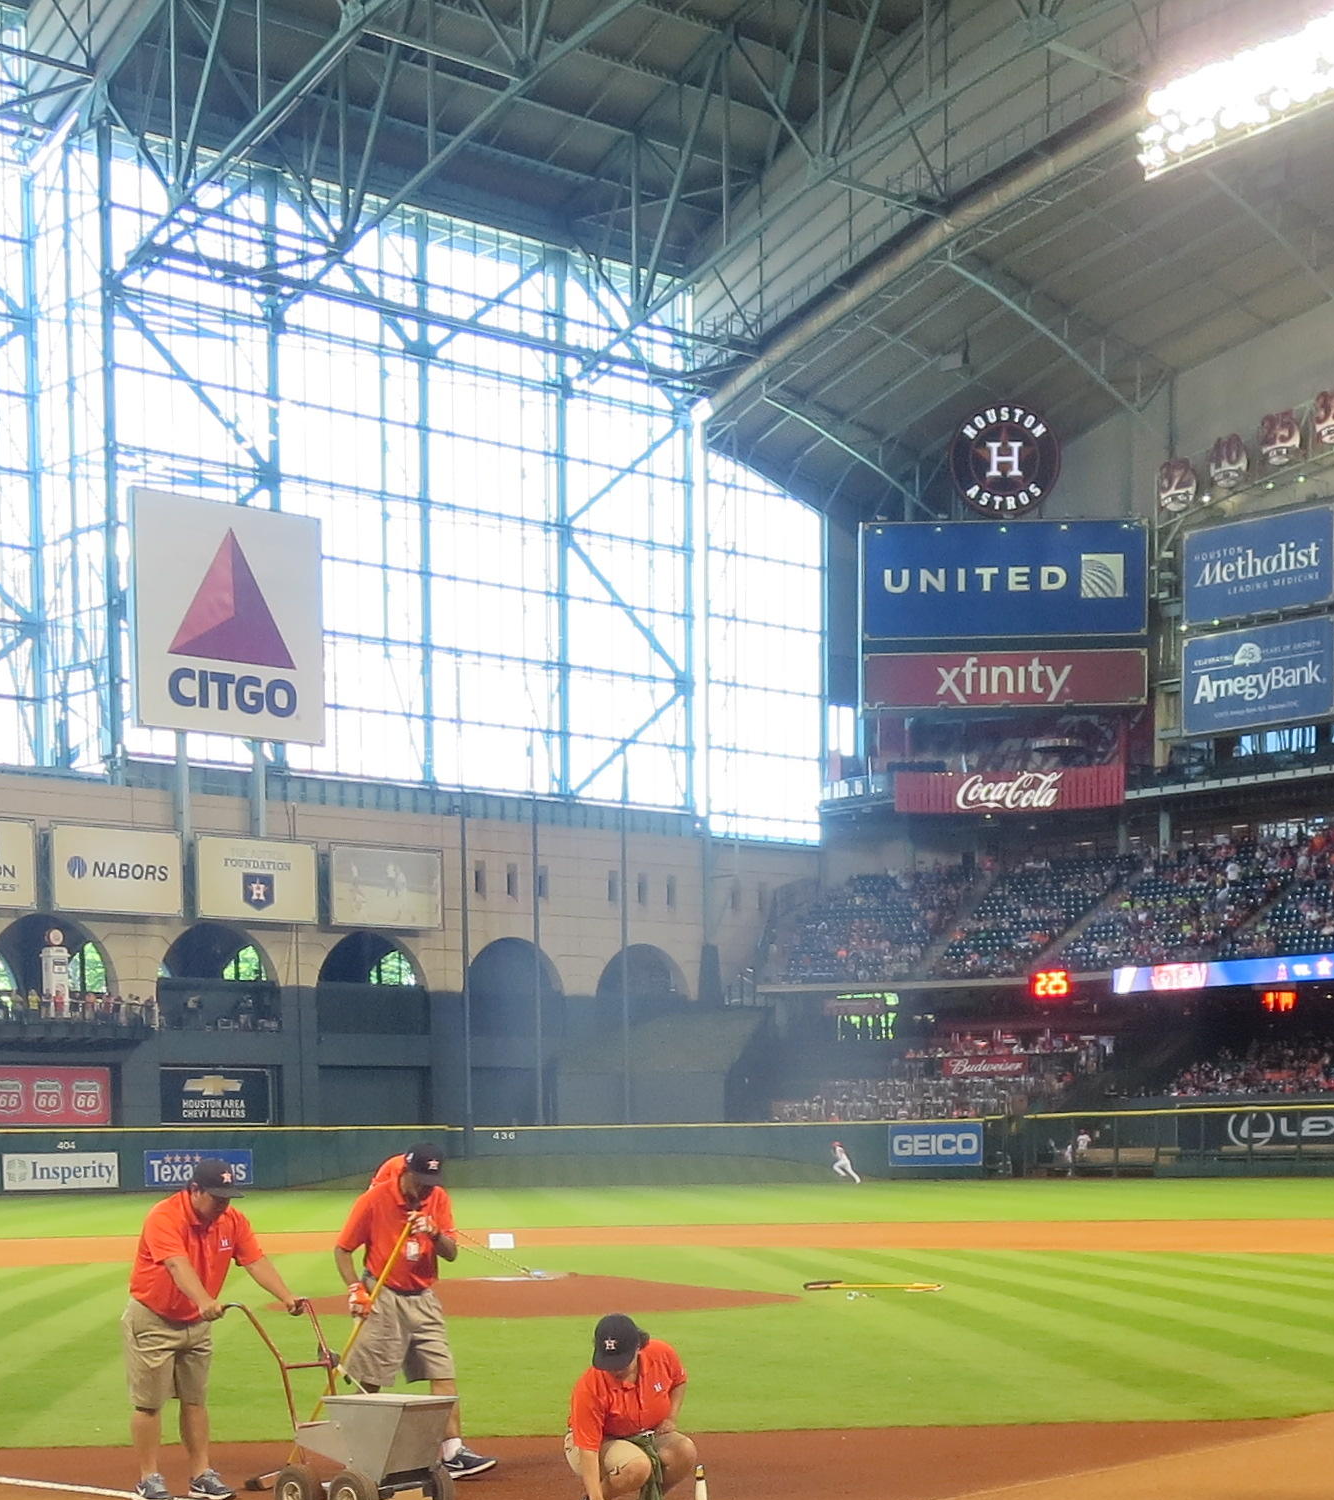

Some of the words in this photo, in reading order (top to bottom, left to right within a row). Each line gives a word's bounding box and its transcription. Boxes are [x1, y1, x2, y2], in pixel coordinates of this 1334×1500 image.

[962, 406, 1047, 439] HOUSTON
[985, 441, 1023, 477] H
[966, 483, 1042, 510] ASTROS
[1194, 546, 1243, 561] HOUSTON
[1194, 541, 1319, 588] Methodist
[883, 565, 1067, 594] UNITED
[935, 656, 1072, 704] xfinity
[1193, 660, 1322, 705] AmegyBank
[168, 667, 298, 718] CITGO
[92, 861, 168, 882] NABORS
[223, 857, 291, 871] FOUNDATION
[950, 1058, 1022, 1075] Budweiser
[77, 1094, 97, 1108] 66
[182, 1099, 222, 1109] HOUSTON
[223, 1099, 245, 1109] AREA
[182, 1108, 209, 1119] CHEVY
[210, 1108, 246, 1119] DEALERS
[57, 1141, 75, 1150] 404
[492, 1131, 516, 1140] 436
[892, 1132, 979, 1157] GEICO
[31, 1160, 115, 1184] Insperity
